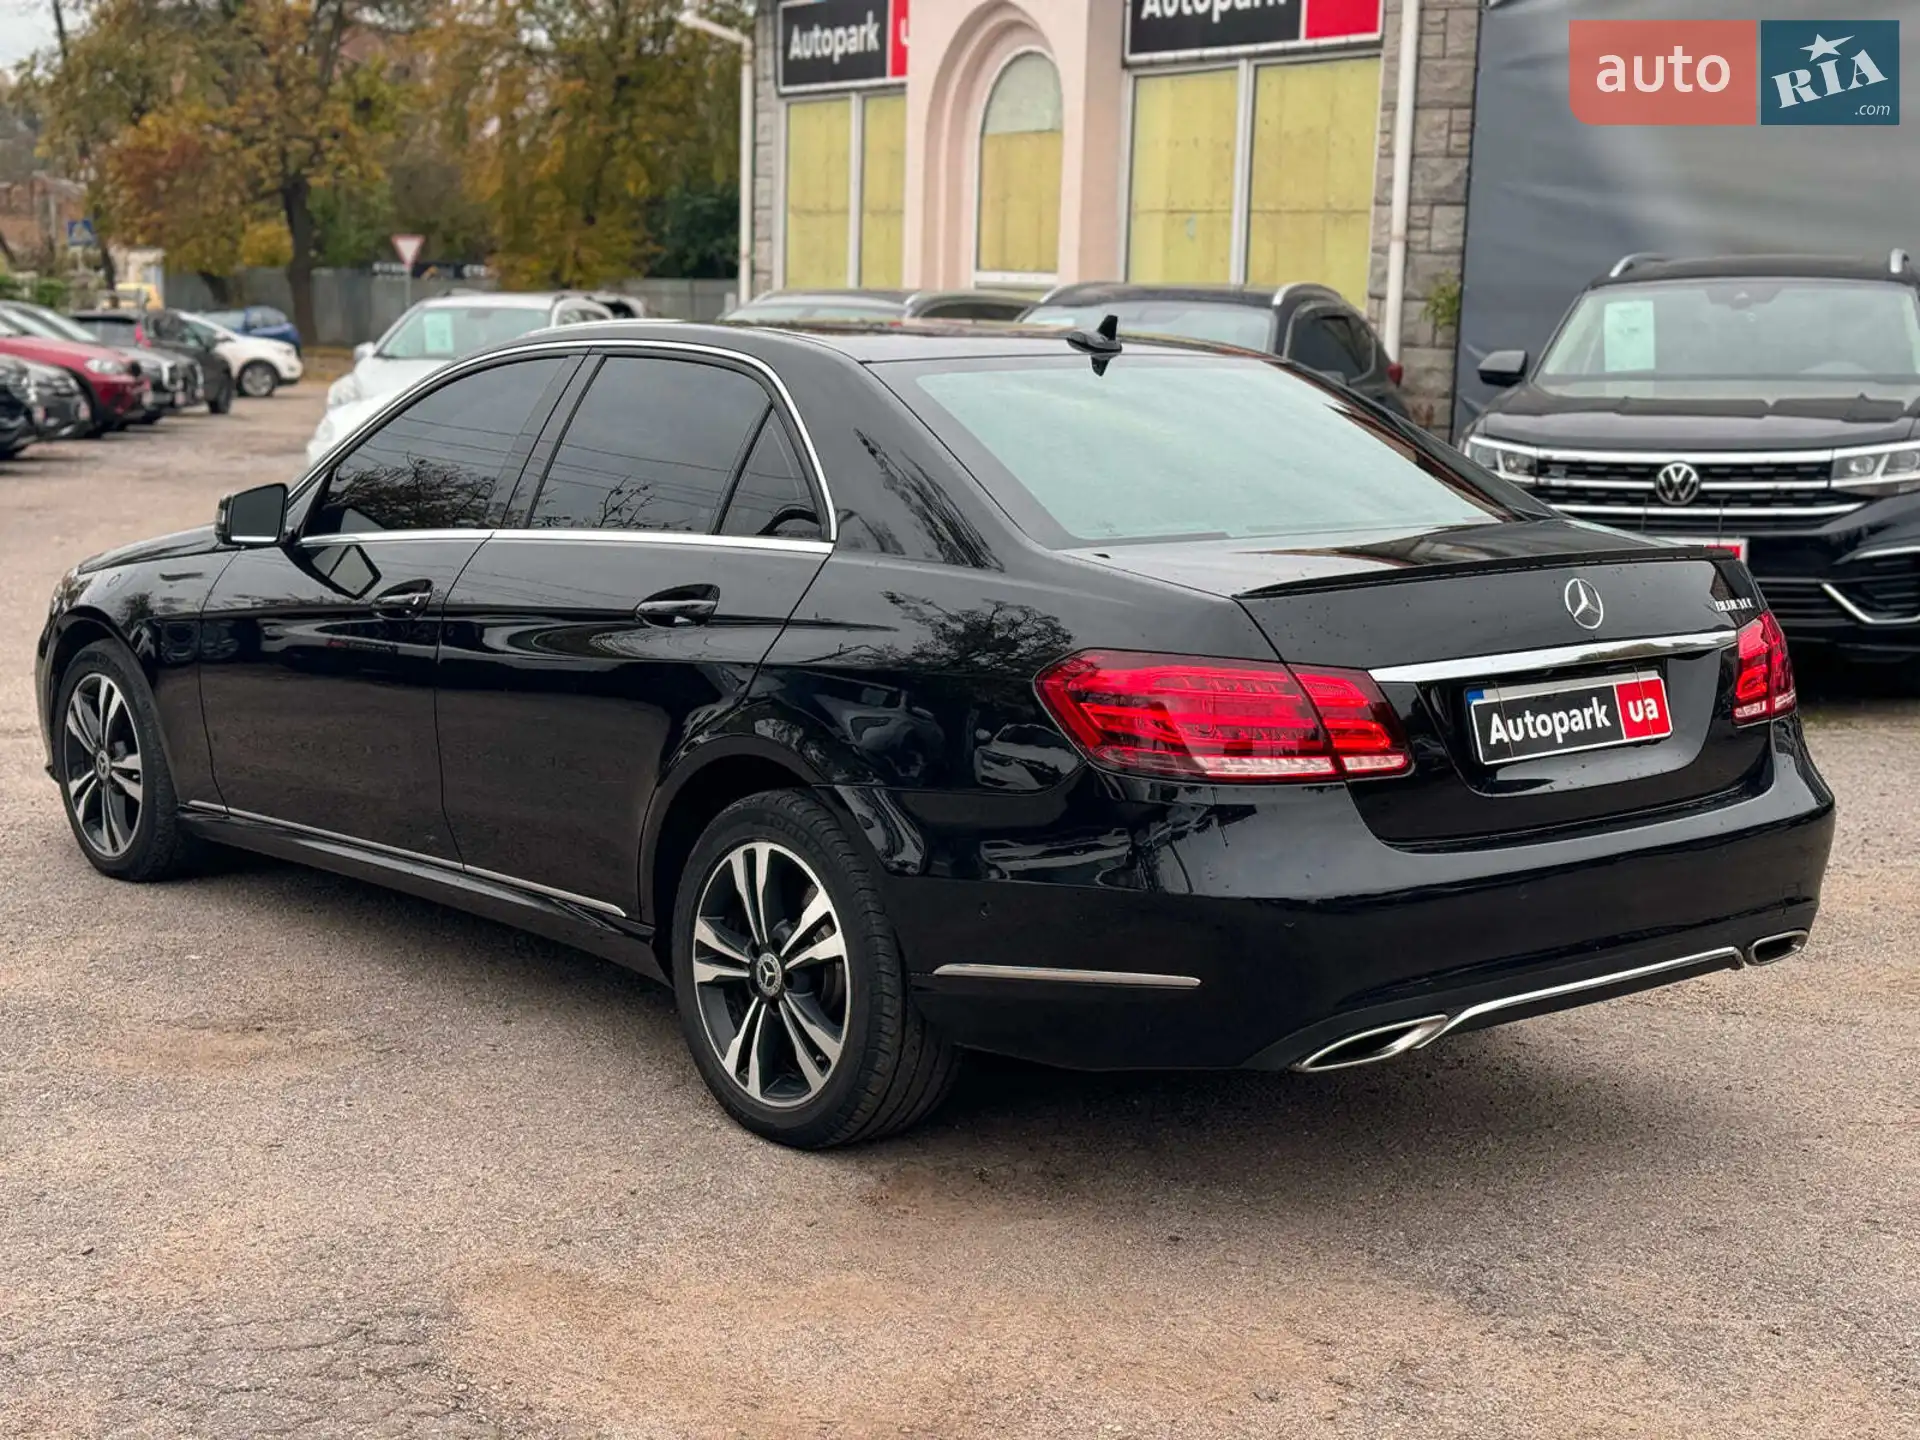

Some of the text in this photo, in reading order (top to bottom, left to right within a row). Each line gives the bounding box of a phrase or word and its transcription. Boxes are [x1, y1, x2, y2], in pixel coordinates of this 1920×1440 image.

[788, 9, 880, 65] Autopark
[1489, 697, 1659, 744] Autopark ua
